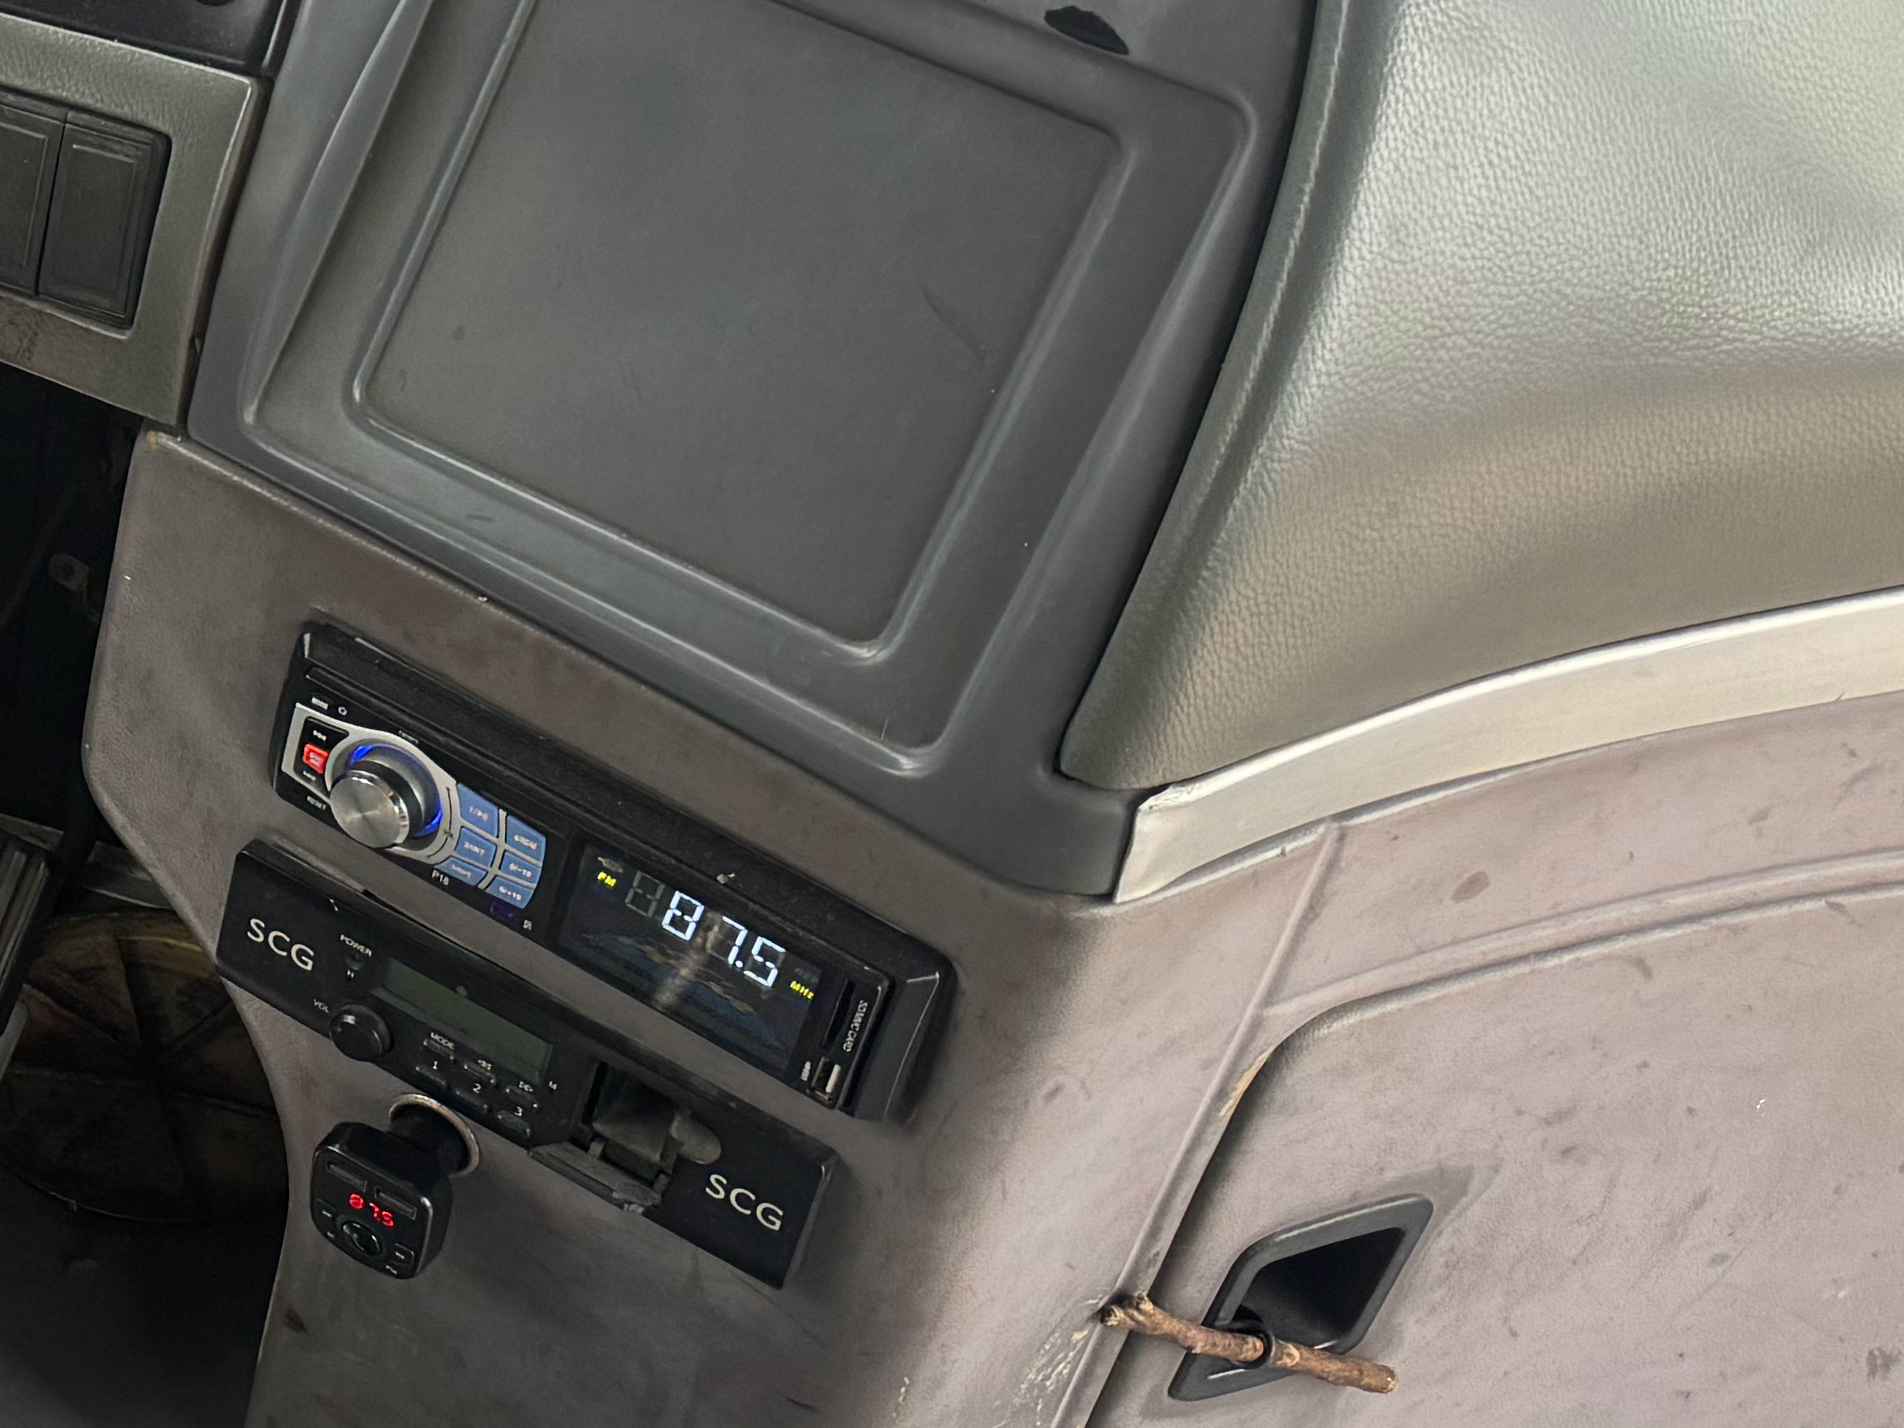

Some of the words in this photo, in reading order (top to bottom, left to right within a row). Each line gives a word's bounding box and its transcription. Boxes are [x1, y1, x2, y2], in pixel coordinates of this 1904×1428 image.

[246, 918, 315, 972] SCG
[340, 933, 373, 958] POWER
[661, 890, 786, 988] 87.5
[790, 980, 814, 1001] MHz
[313, 998, 330, 1014] VOL
[430, 1032, 456, 1051] MODE
[705, 1174, 784, 1231] SCG
